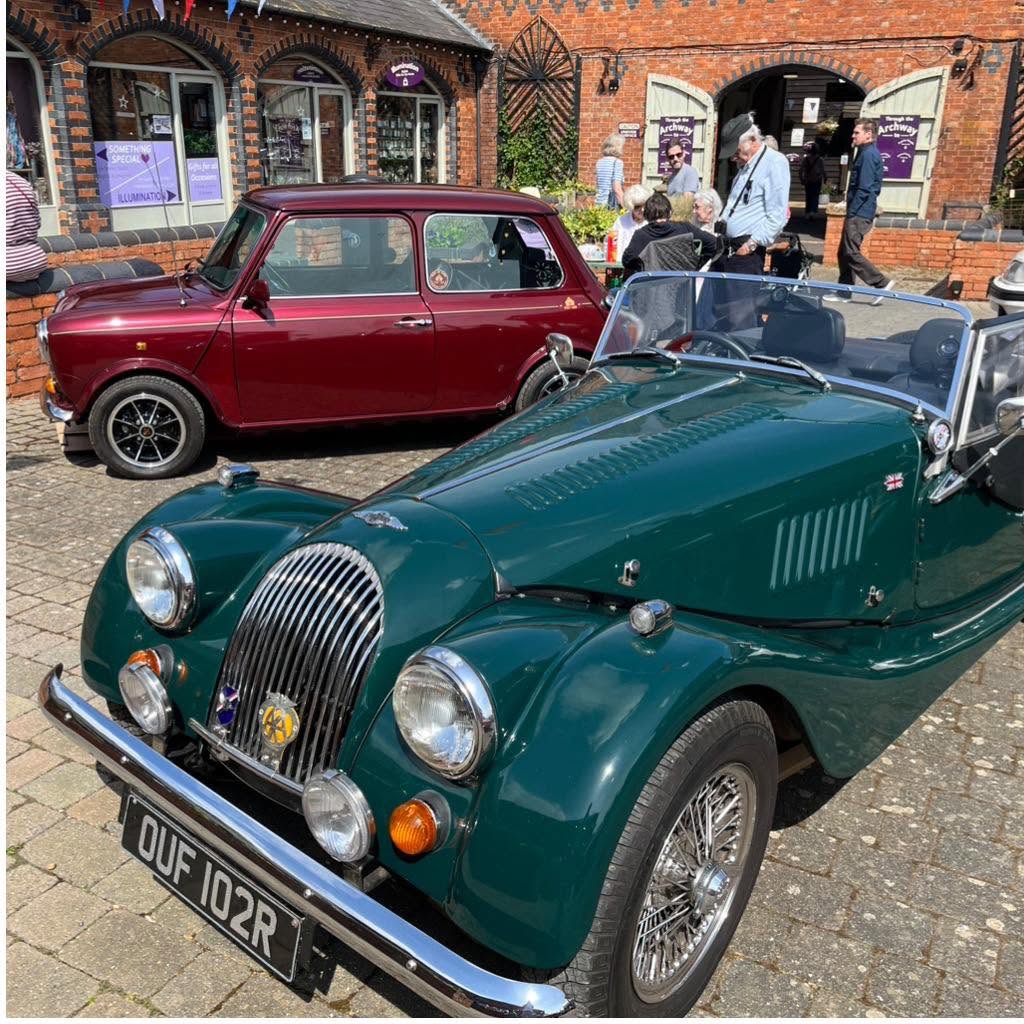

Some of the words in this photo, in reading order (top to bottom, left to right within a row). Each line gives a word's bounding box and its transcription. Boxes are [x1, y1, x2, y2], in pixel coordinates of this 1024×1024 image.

[660, 123, 693, 136] Archway
[878, 121, 918, 136] Archway
[108, 144, 152, 154] SOMETHING
[111, 155, 141, 164] SPECIAL
[117, 191, 167, 203] ILLUMINATION
[138, 814, 197, 885] OUF
[200, 860, 277, 958] 102R
